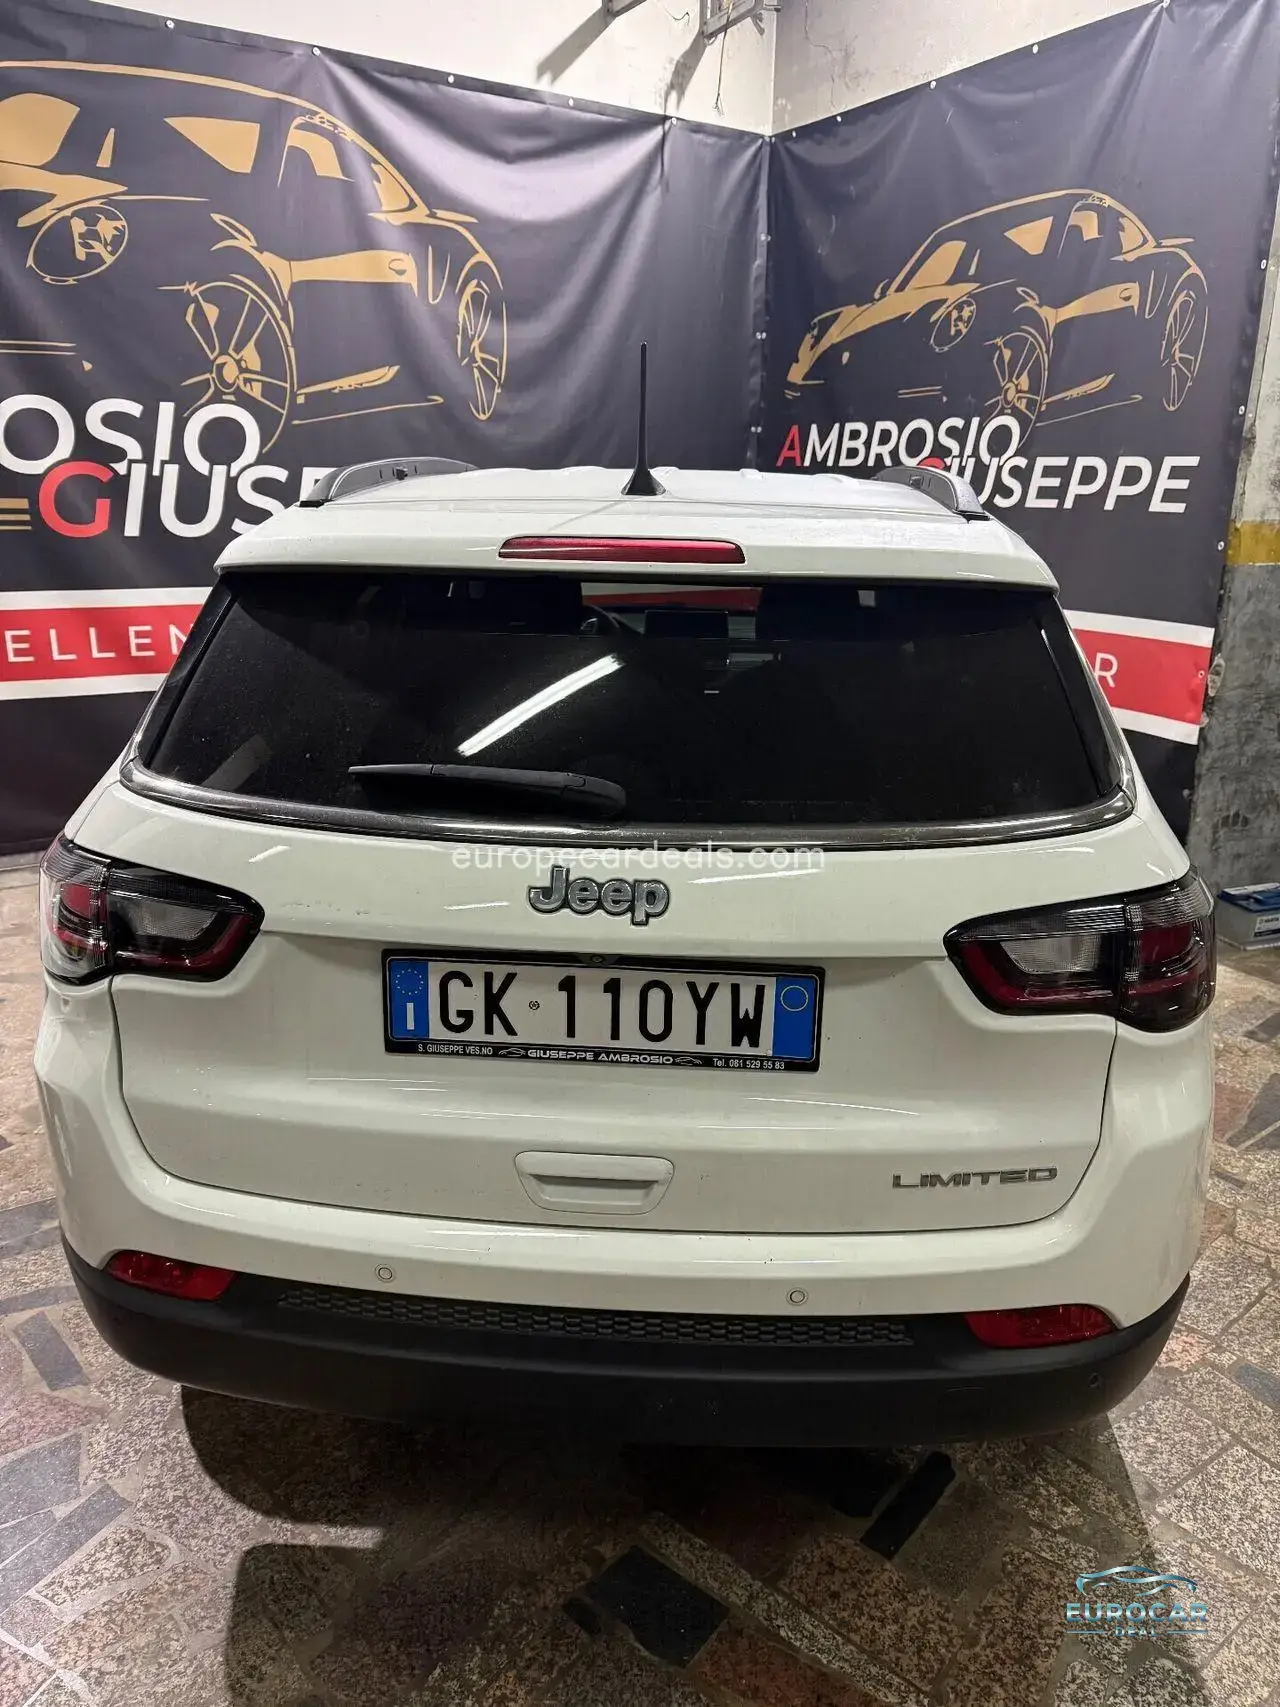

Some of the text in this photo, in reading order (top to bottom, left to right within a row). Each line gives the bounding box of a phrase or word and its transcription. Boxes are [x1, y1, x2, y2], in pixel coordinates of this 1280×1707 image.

[776, 414, 1021, 468] AMBROSIO
[38, 460, 342, 538] GIUS
[917, 455, 1200, 513] USEPPE
[528, 865, 671, 926] Jeep
[439, 969, 766, 1048] GK 110YW
[426, 1043, 464, 1055] GIUSEPPE
[465, 1045, 494, 1056] VES.NO
[527, 1048, 595, 1061] GIUSEPPE
[597, 1053, 674, 1065] AMBROSIO
[712, 1058, 727, 1068] Tel.
[746, 1060, 760, 1069] 529
[762, 1060, 773, 1070] 55
[774, 1061, 785, 1071] 83
[892, 1166, 1058, 1188] LIMITED
